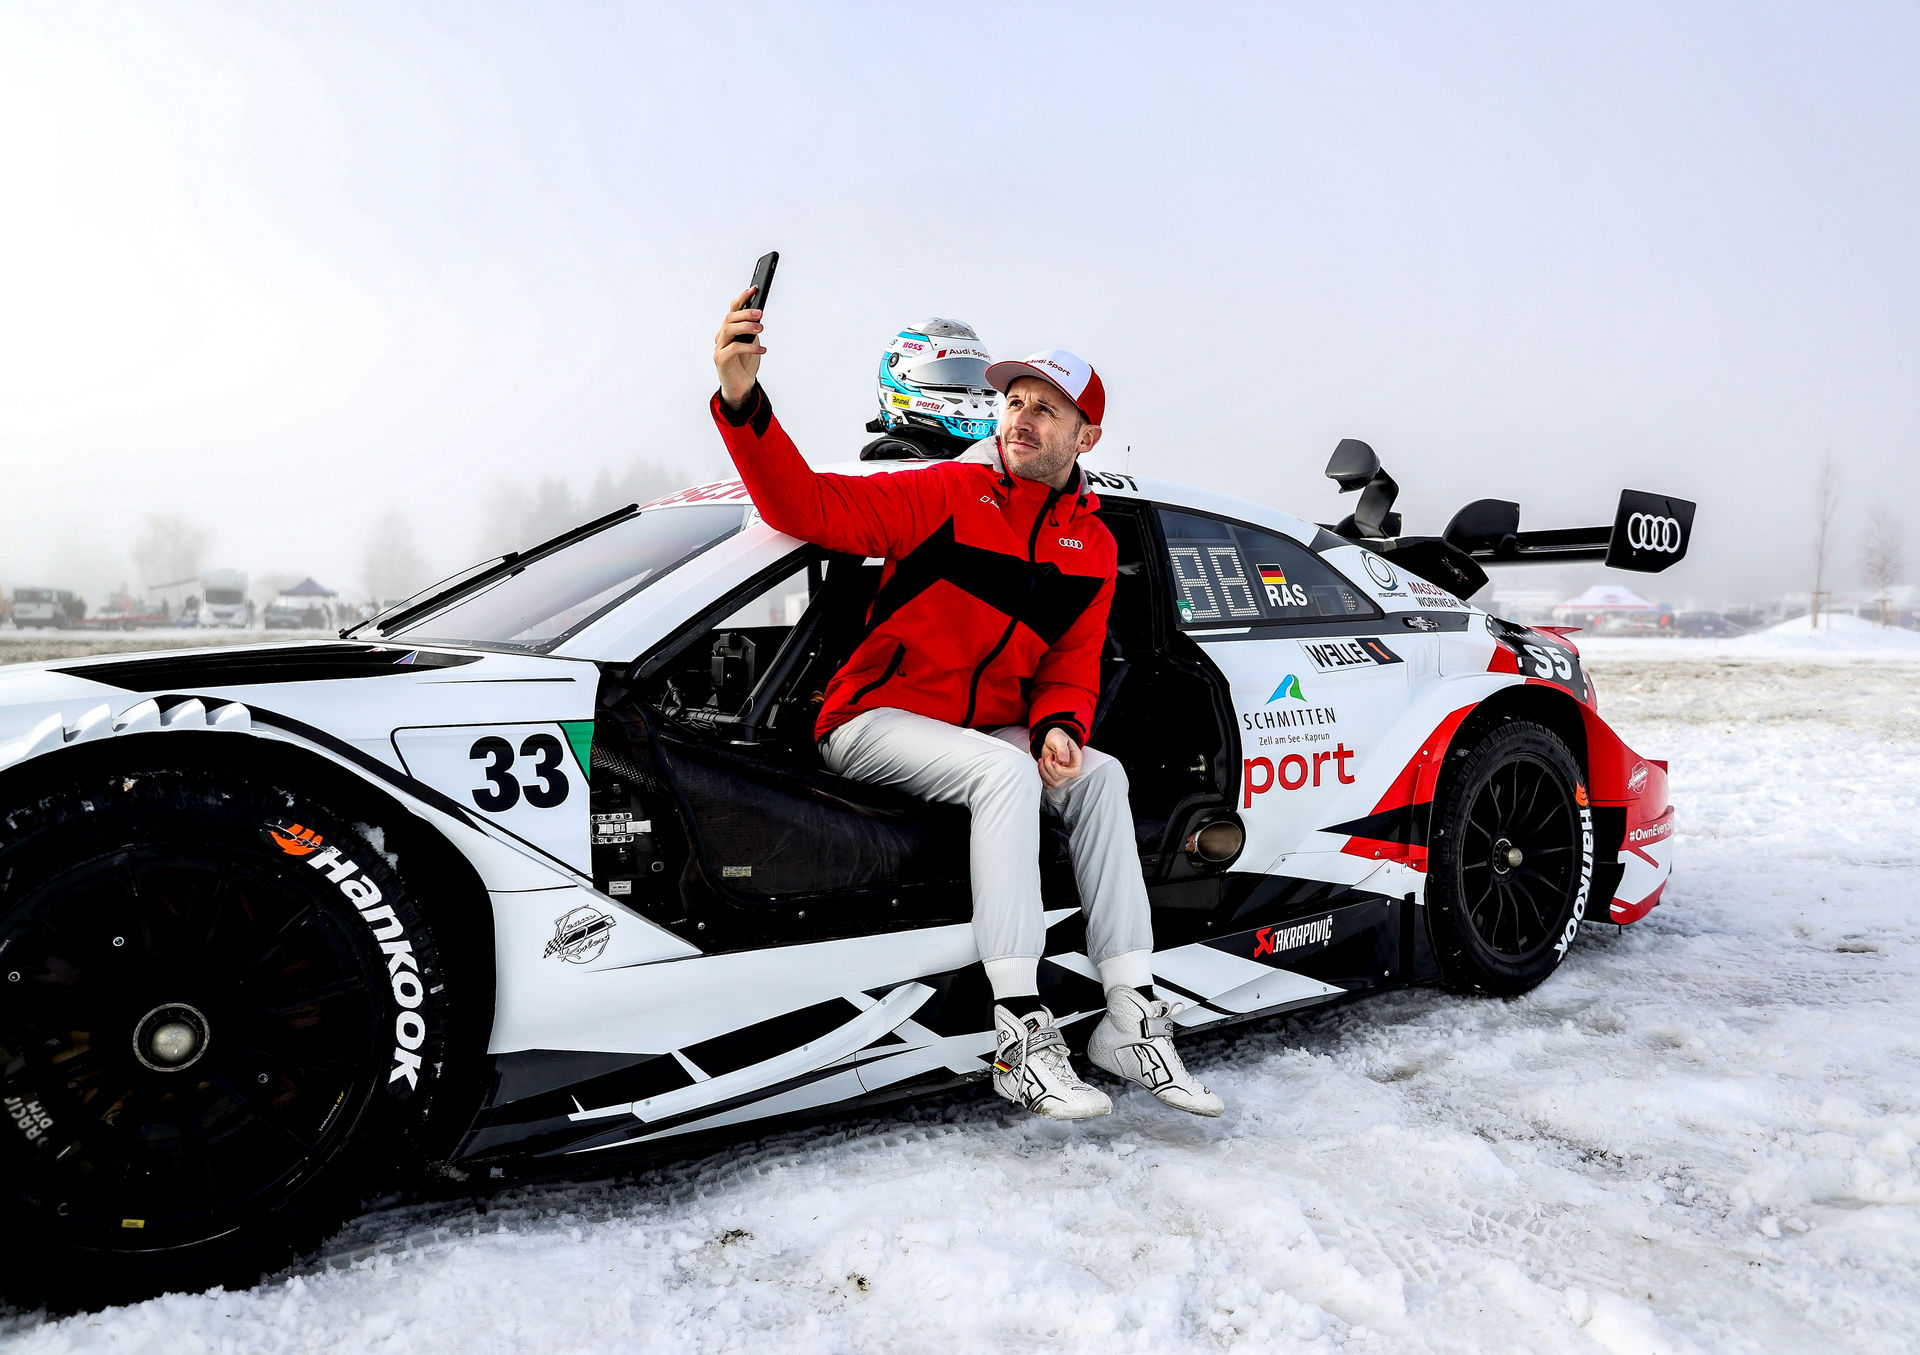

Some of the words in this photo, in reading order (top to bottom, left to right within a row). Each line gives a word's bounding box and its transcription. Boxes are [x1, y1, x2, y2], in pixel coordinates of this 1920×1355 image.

[1047, 360, 1071, 377] Sport
[916, 400, 945, 413] porta!
[1084, 469, 1139, 492] AST
[1264, 583, 1309, 608] RAS
[1415, 596, 1461, 609] WORKWEAR
[1523, 644, 1573, 681] S5
[1243, 707, 1337, 731] SCHMITTEN
[1259, 736, 1273, 746] Zell
[469, 735, 570, 813] 33
[1553, 809, 1594, 963] Hankook
[306, 845, 426, 1092] Hankook
[27, 1101, 54, 1130] DTM
